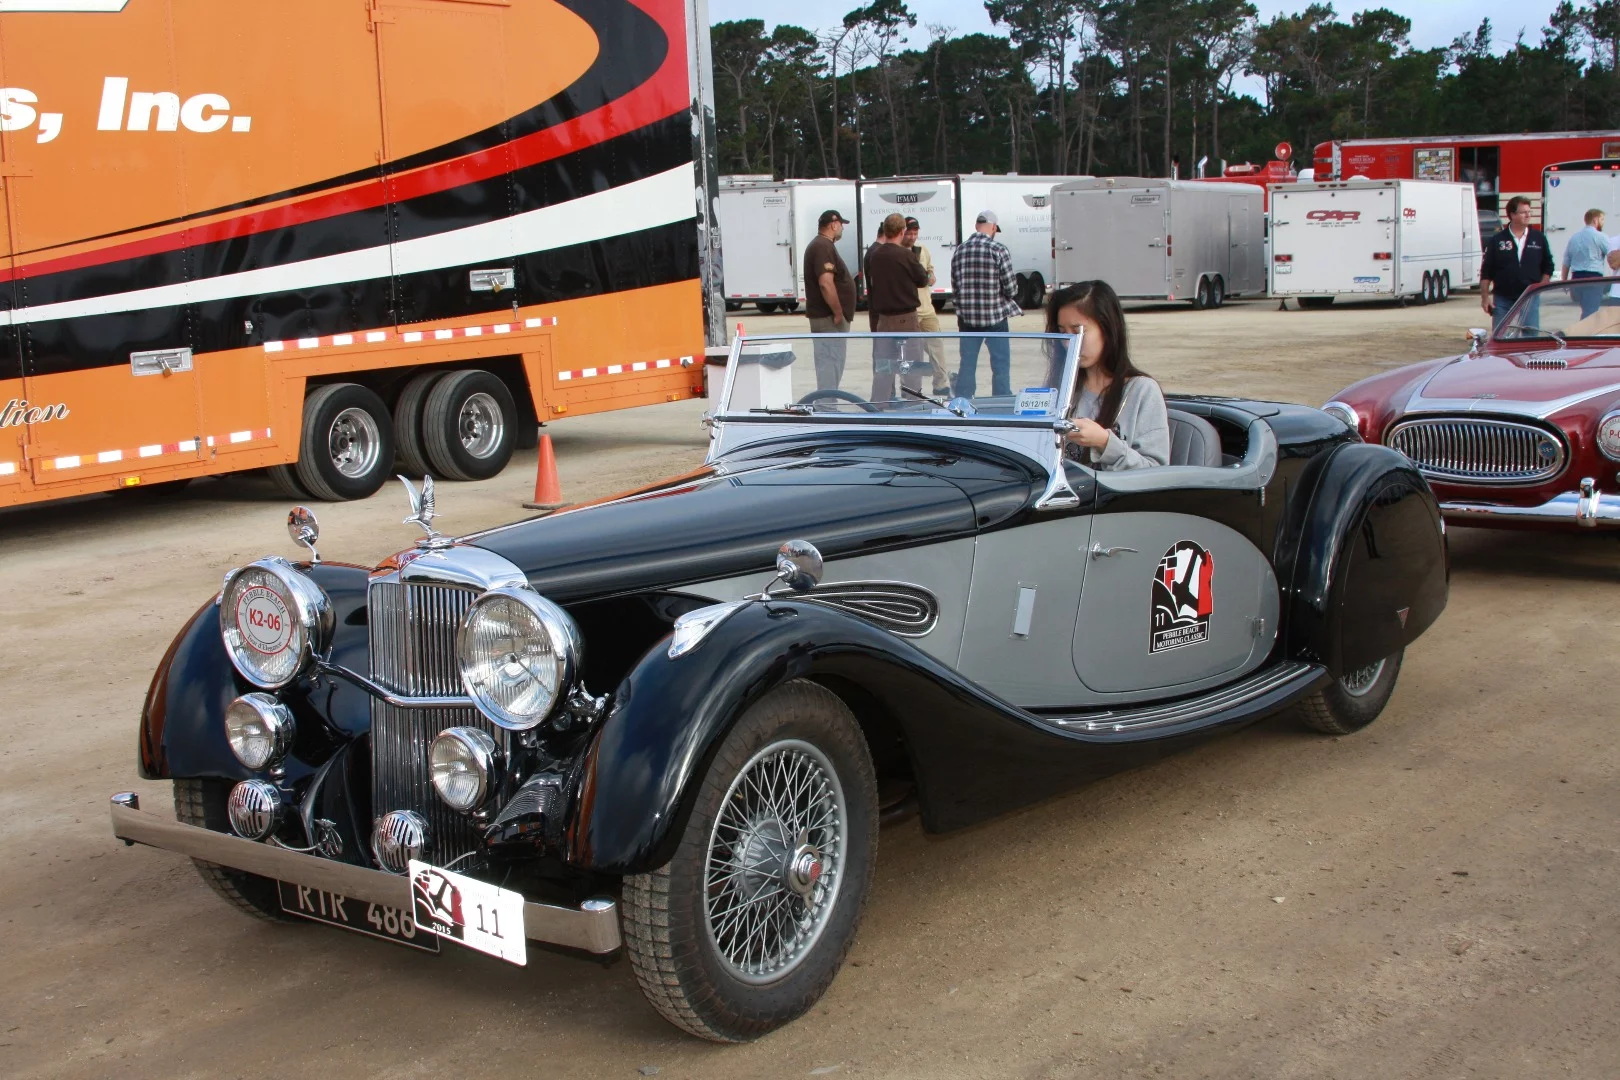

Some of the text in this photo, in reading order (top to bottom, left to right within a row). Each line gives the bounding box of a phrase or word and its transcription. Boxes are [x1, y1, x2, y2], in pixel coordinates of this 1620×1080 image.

[97, 76, 252, 133] Inc.
[243, 588, 286, 614] PEBBLE BEACH
[250, 608, 280, 631] K2-06
[1155, 613, 1164, 626] 11
[1157, 632, 1204, 648] MOTORING CLASSIC
[1163, 626, 1199, 640] PEBBLE BEACH
[432, 922, 452, 935] 2015
[477, 903, 504, 939] 11
